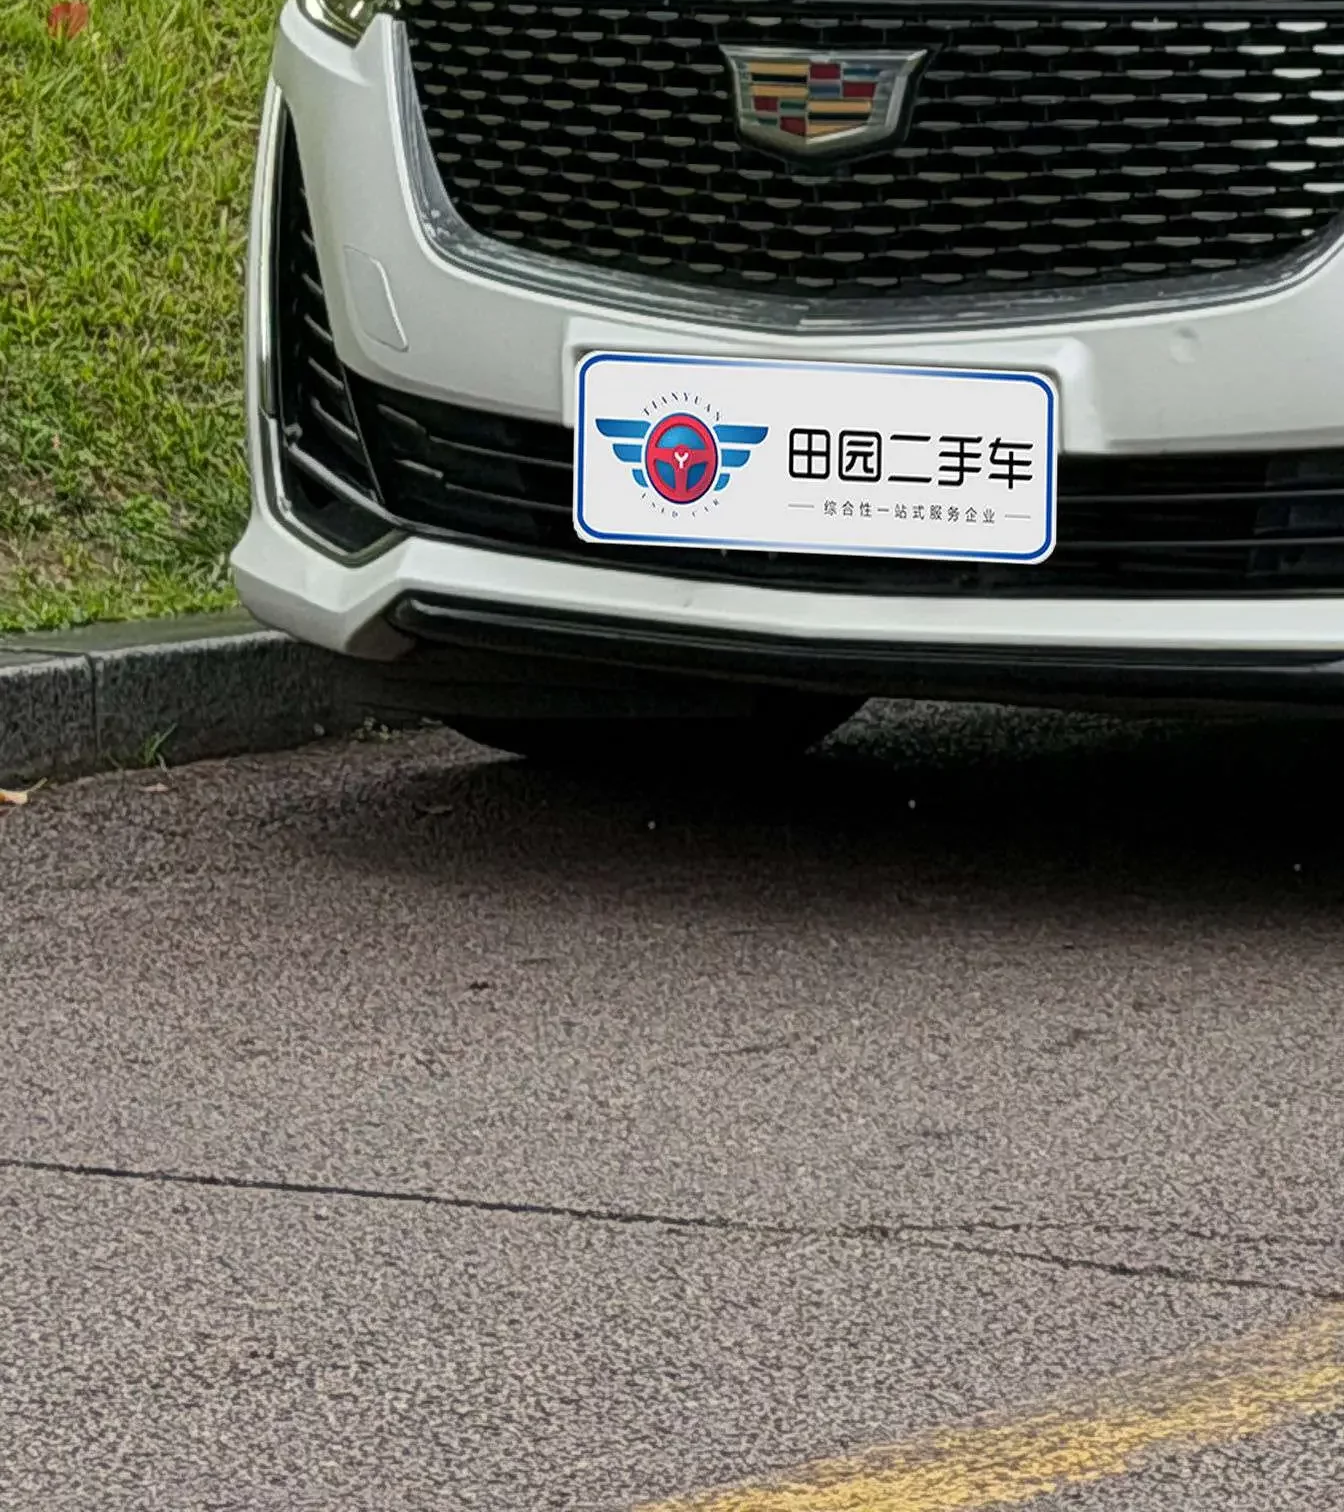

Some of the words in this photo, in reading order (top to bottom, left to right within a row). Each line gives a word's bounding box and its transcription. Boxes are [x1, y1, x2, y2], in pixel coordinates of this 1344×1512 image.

[788, 427, 1034, 490] 田园二手车
[823, 499, 997, 525] 综合性一站式服务企业
